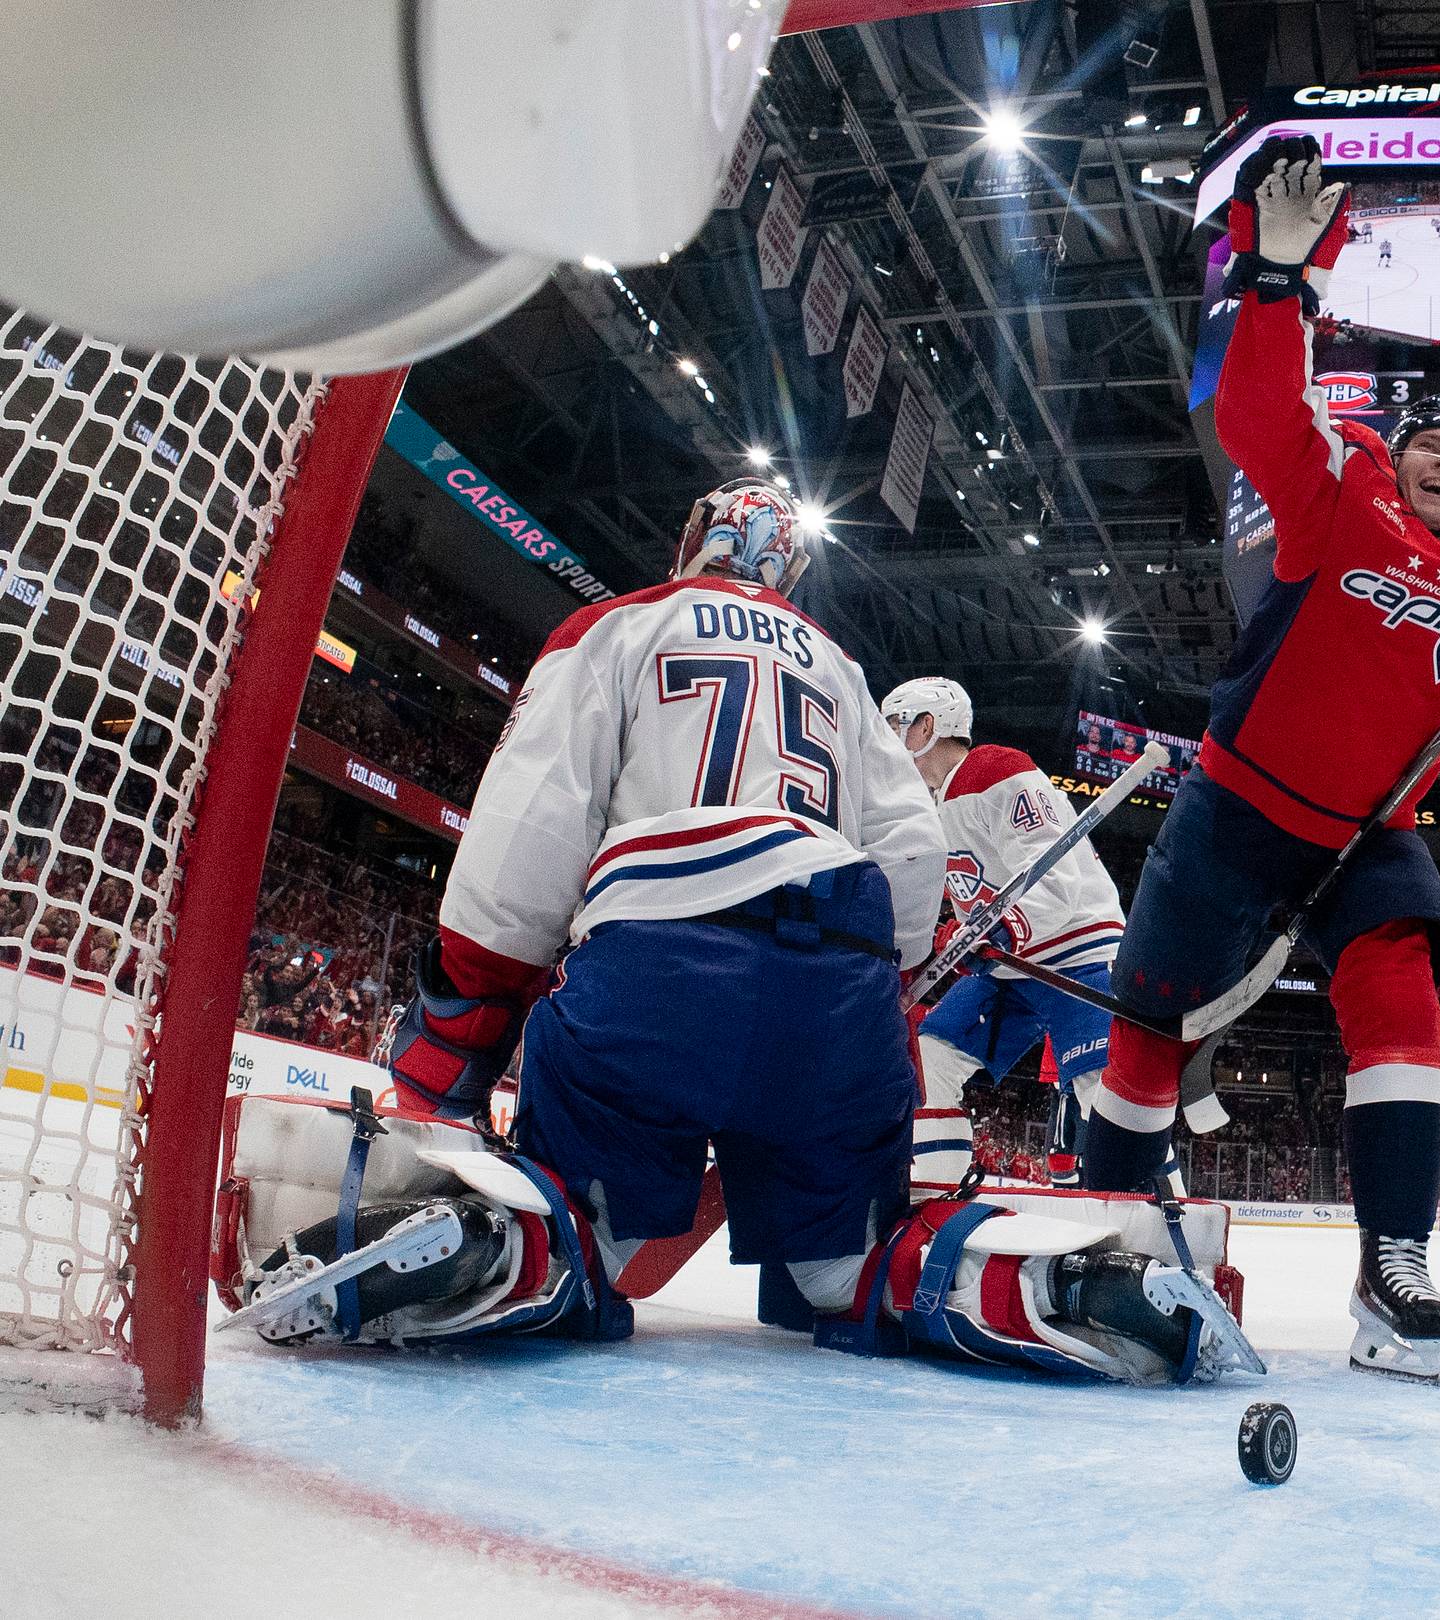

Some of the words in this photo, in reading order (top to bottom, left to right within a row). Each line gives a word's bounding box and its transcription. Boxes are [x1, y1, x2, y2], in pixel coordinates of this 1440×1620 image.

[1391, 380, 1409, 402] 3
[1233, 487, 1242, 500] 15
[447, 468, 556, 557] CAESARS
[408, 616, 440, 648] COLOSSAL
[692, 604, 813, 669] DOBEŠ
[481, 666, 509, 693] COLOSSAL
[656, 653, 842, 834] 75
[351, 763, 397, 799] COLOSSAL
[937, 914, 994, 972] HZRDUS
[1280, 980, 1317, 991] COLOSSAL
[287, 1065, 329, 1091] DELL
[1238, 1207, 1303, 1219] ticketmaster
[1369, 1292, 1394, 1317] BAUER
